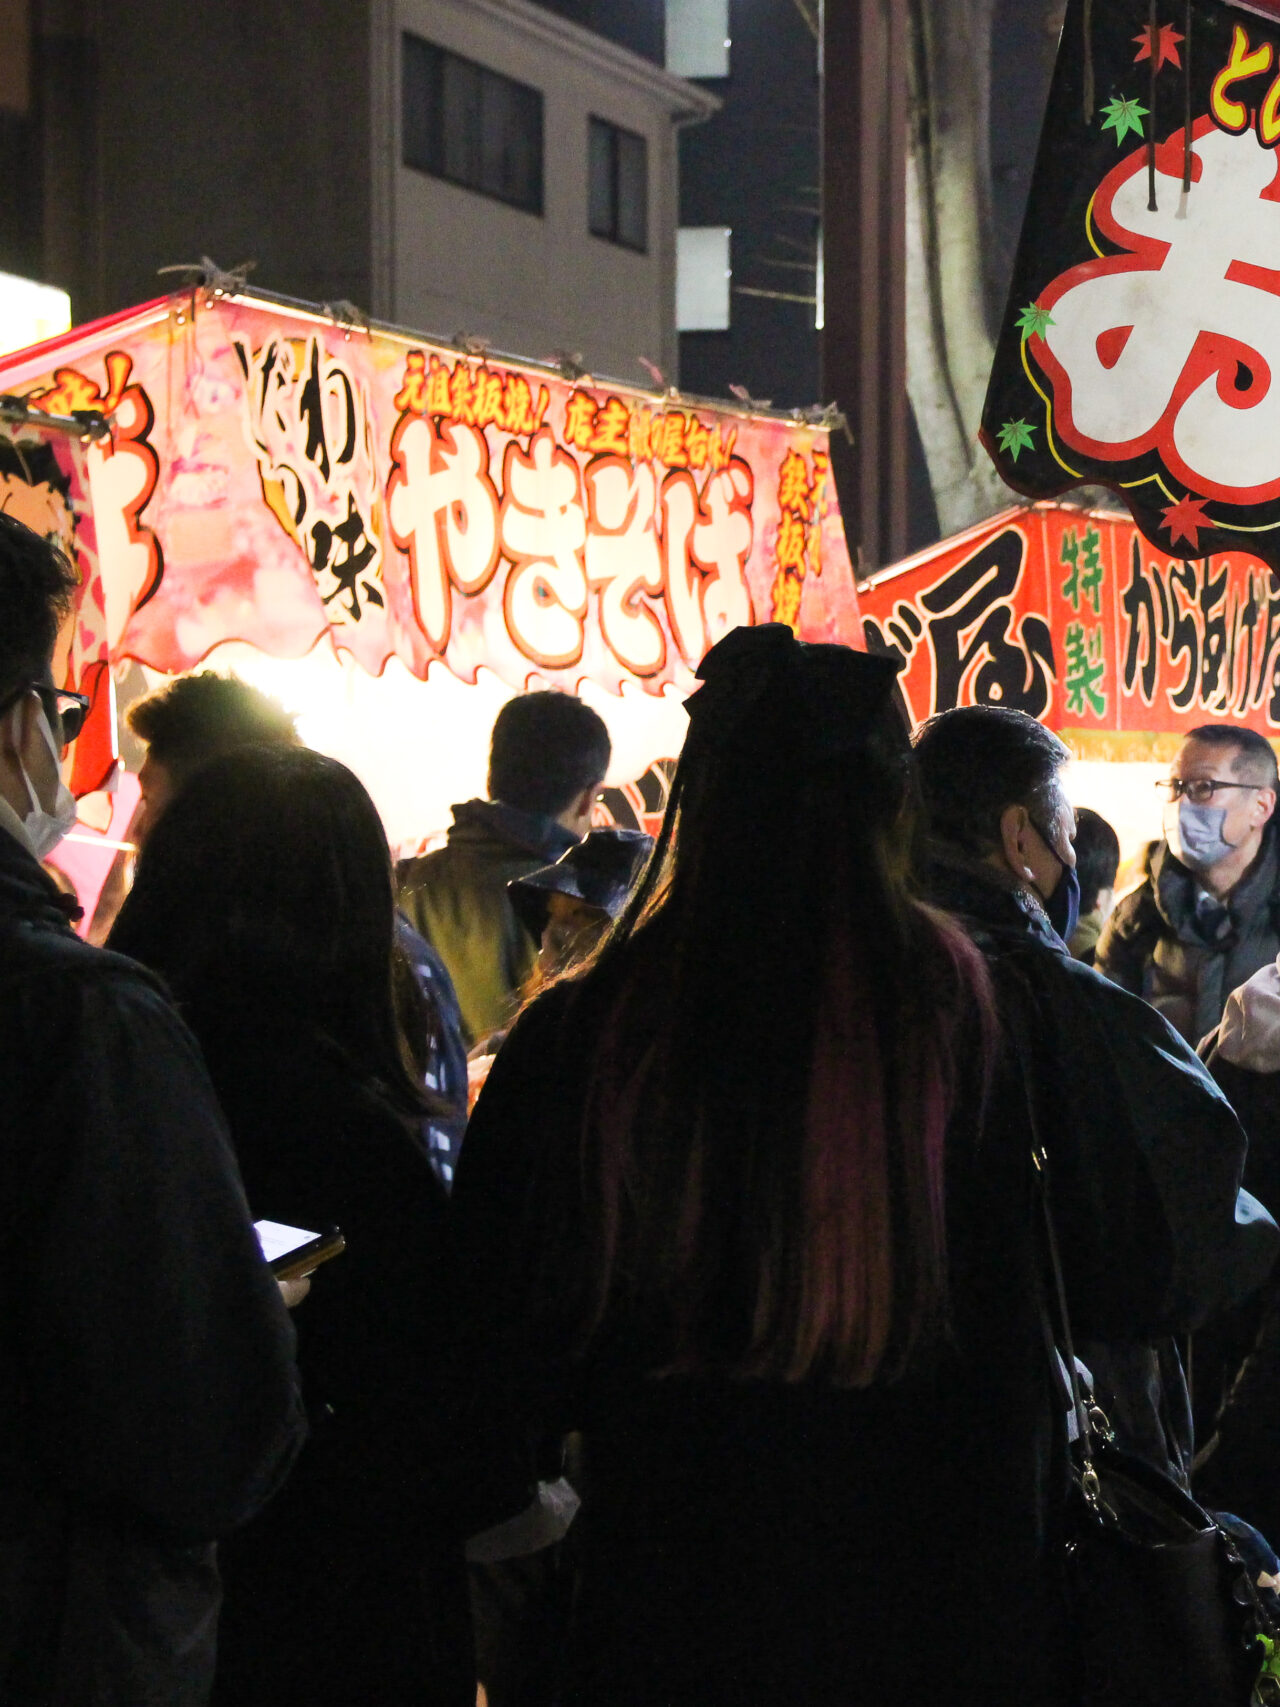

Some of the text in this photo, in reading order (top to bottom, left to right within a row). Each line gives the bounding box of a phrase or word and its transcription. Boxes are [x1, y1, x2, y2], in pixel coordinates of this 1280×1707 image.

[390, 418, 752, 676] やきそば
[1060, 524, 1106, 718] 特製
